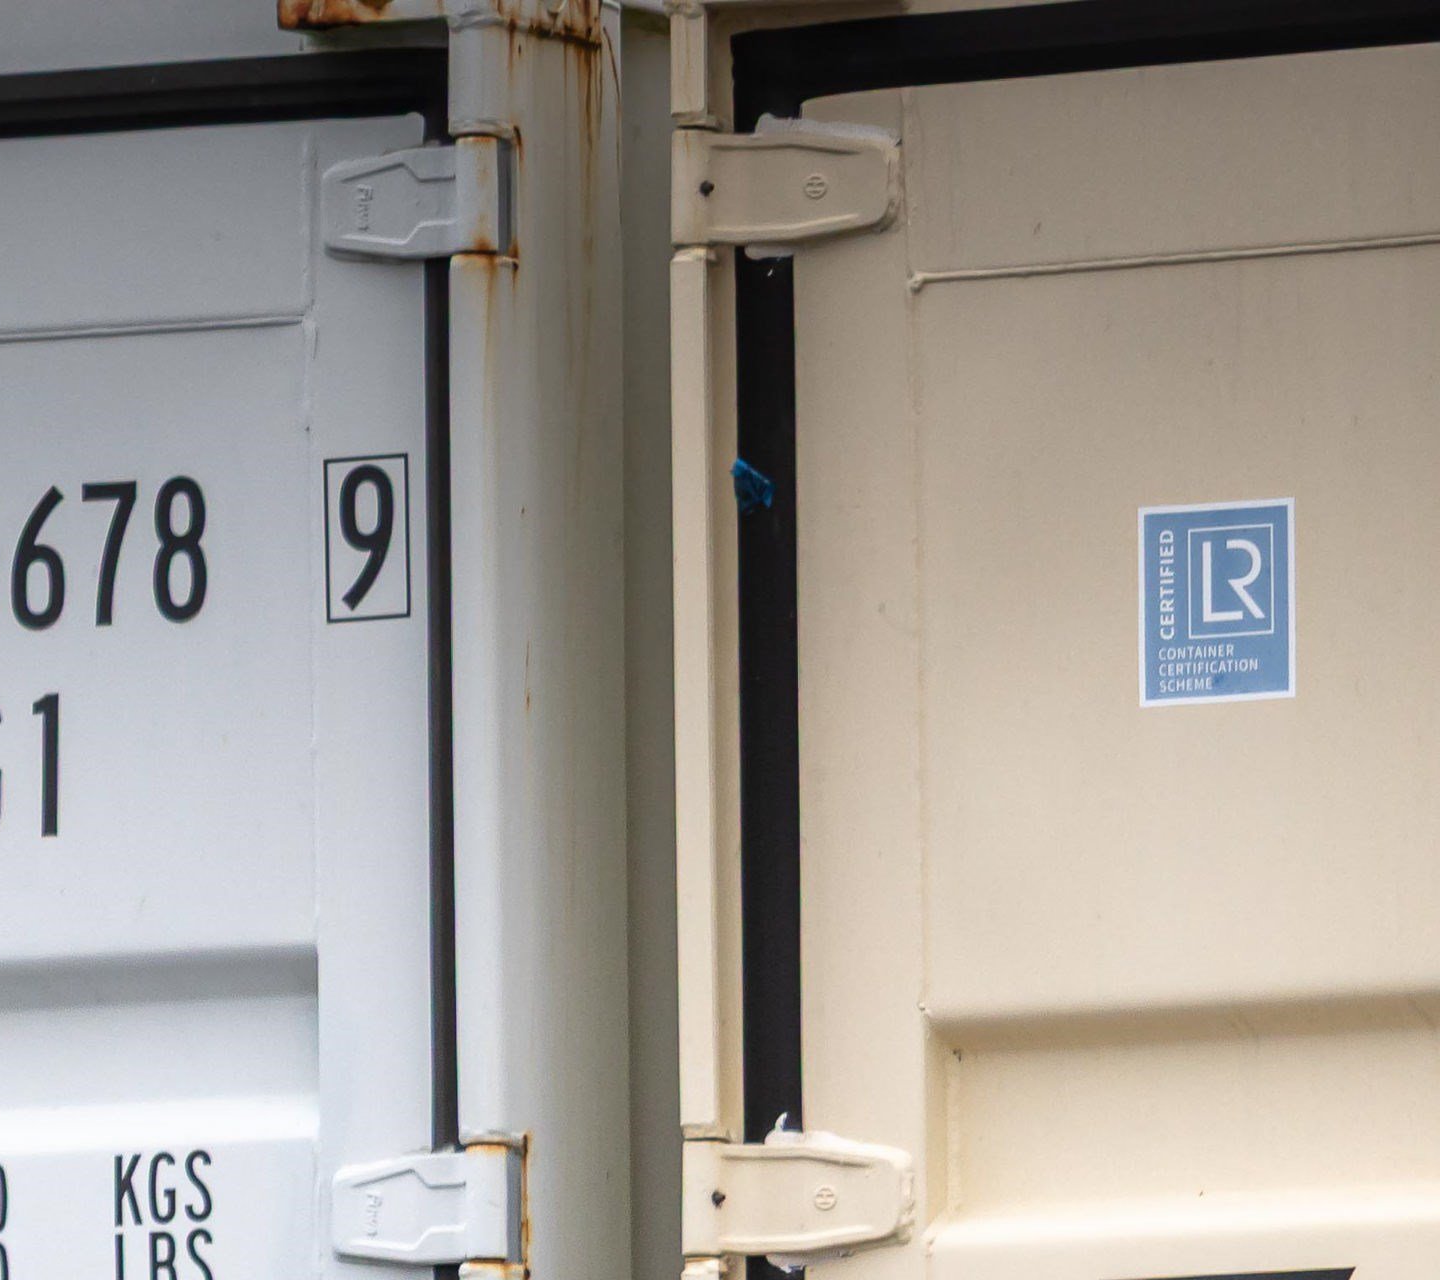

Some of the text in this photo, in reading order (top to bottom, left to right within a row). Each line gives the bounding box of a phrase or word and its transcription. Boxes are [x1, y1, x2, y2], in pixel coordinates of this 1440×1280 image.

[337, 463, 396, 612] 9
[1159, 529, 1175, 640] CERTIFIED
[1202, 538, 1265, 623] LR
[1159, 644, 1234, 661] CONTAINER
[1159, 658, 1258, 677] CERTIFICATION
[1159, 676, 1213, 693] SCHEME
[113, 1149, 214, 1228] KGS
